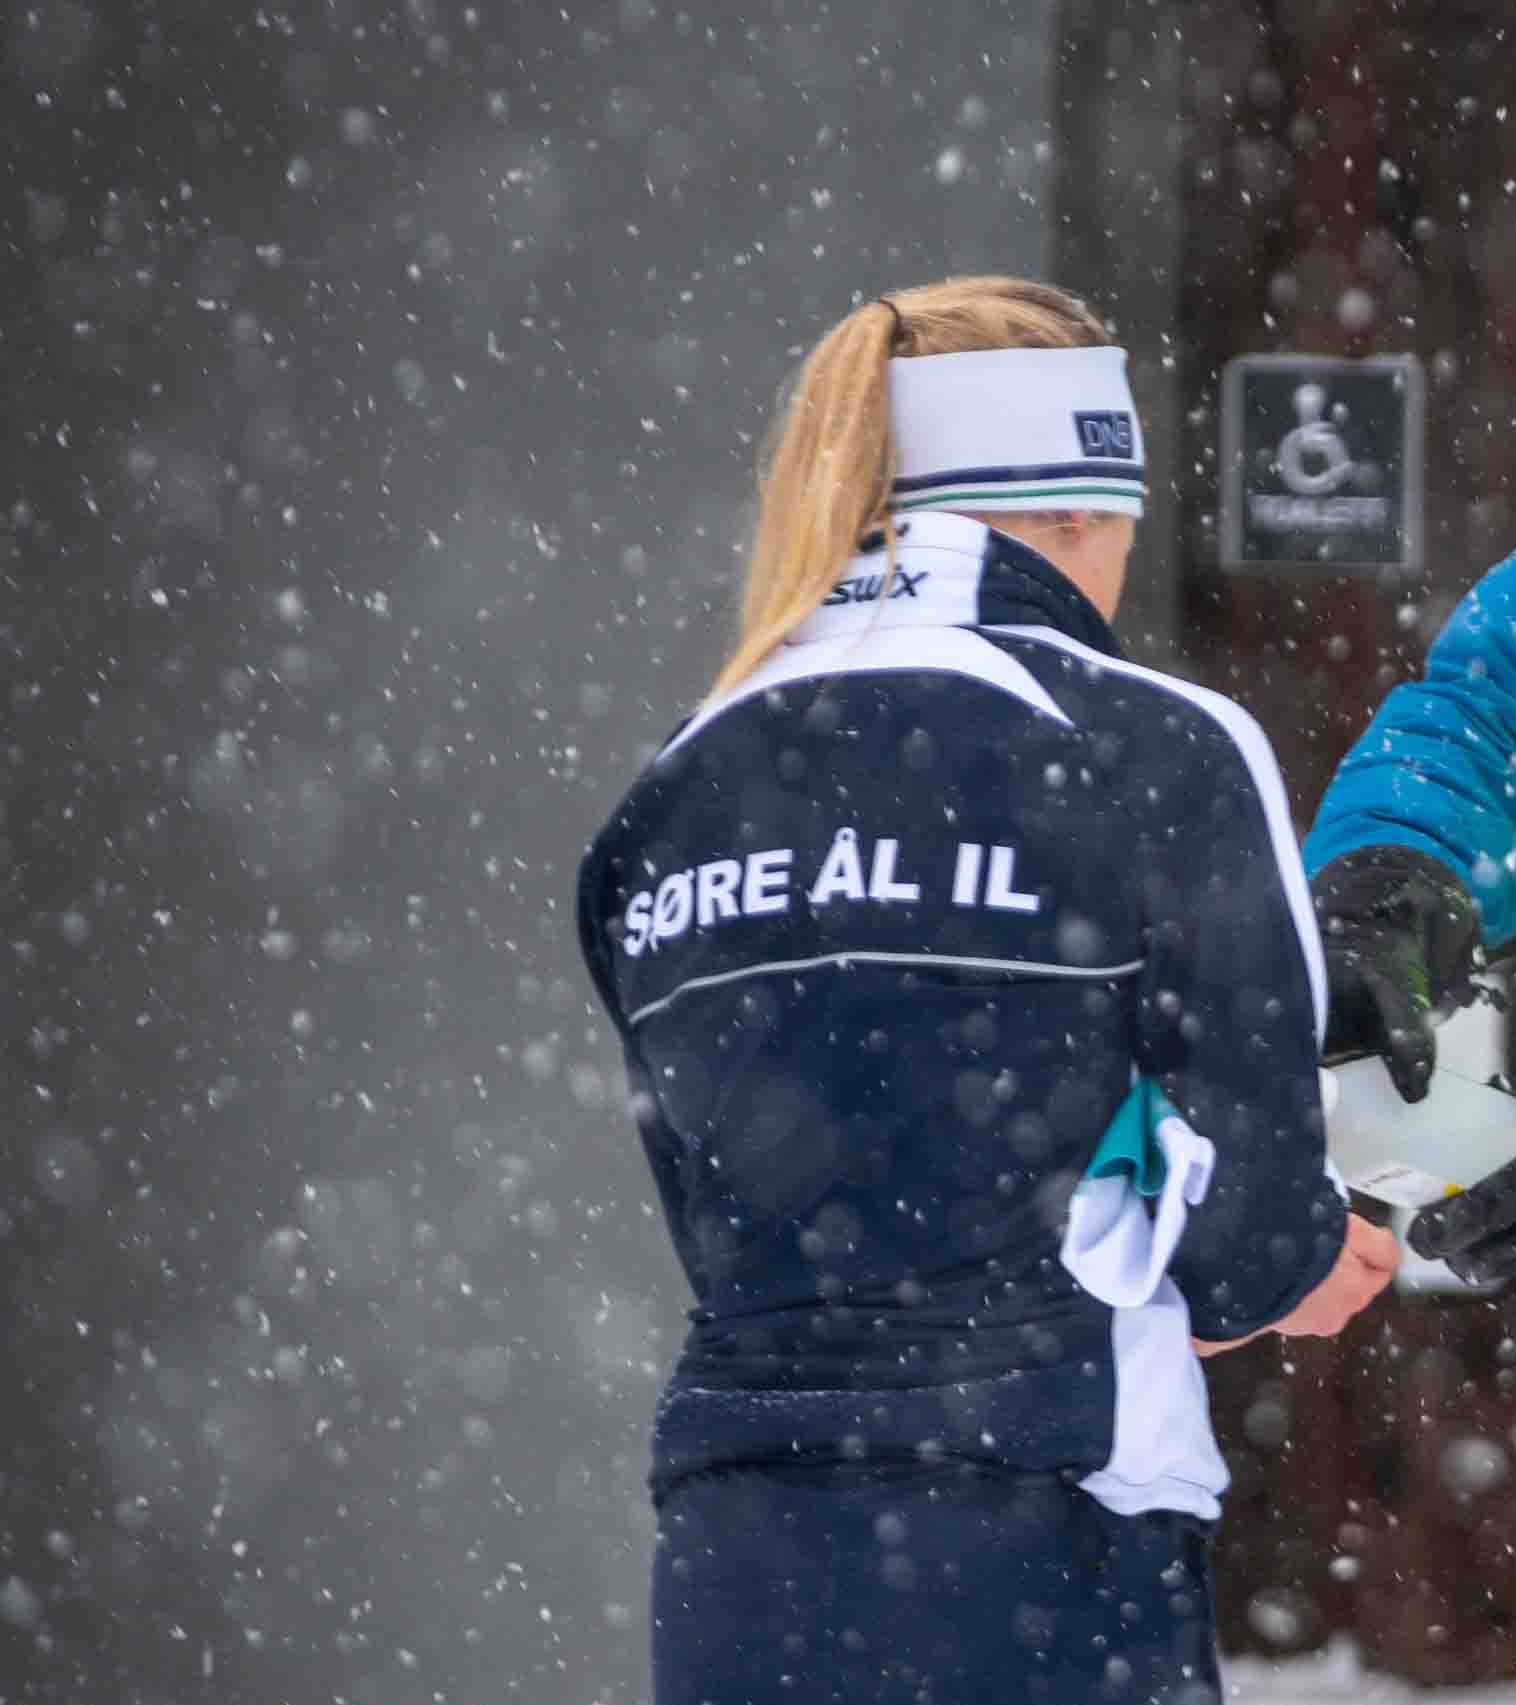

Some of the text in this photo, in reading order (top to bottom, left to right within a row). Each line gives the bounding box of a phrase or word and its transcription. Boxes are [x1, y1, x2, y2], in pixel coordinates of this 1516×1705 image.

[623, 826, 1041, 957] SØRE ÅL IL
